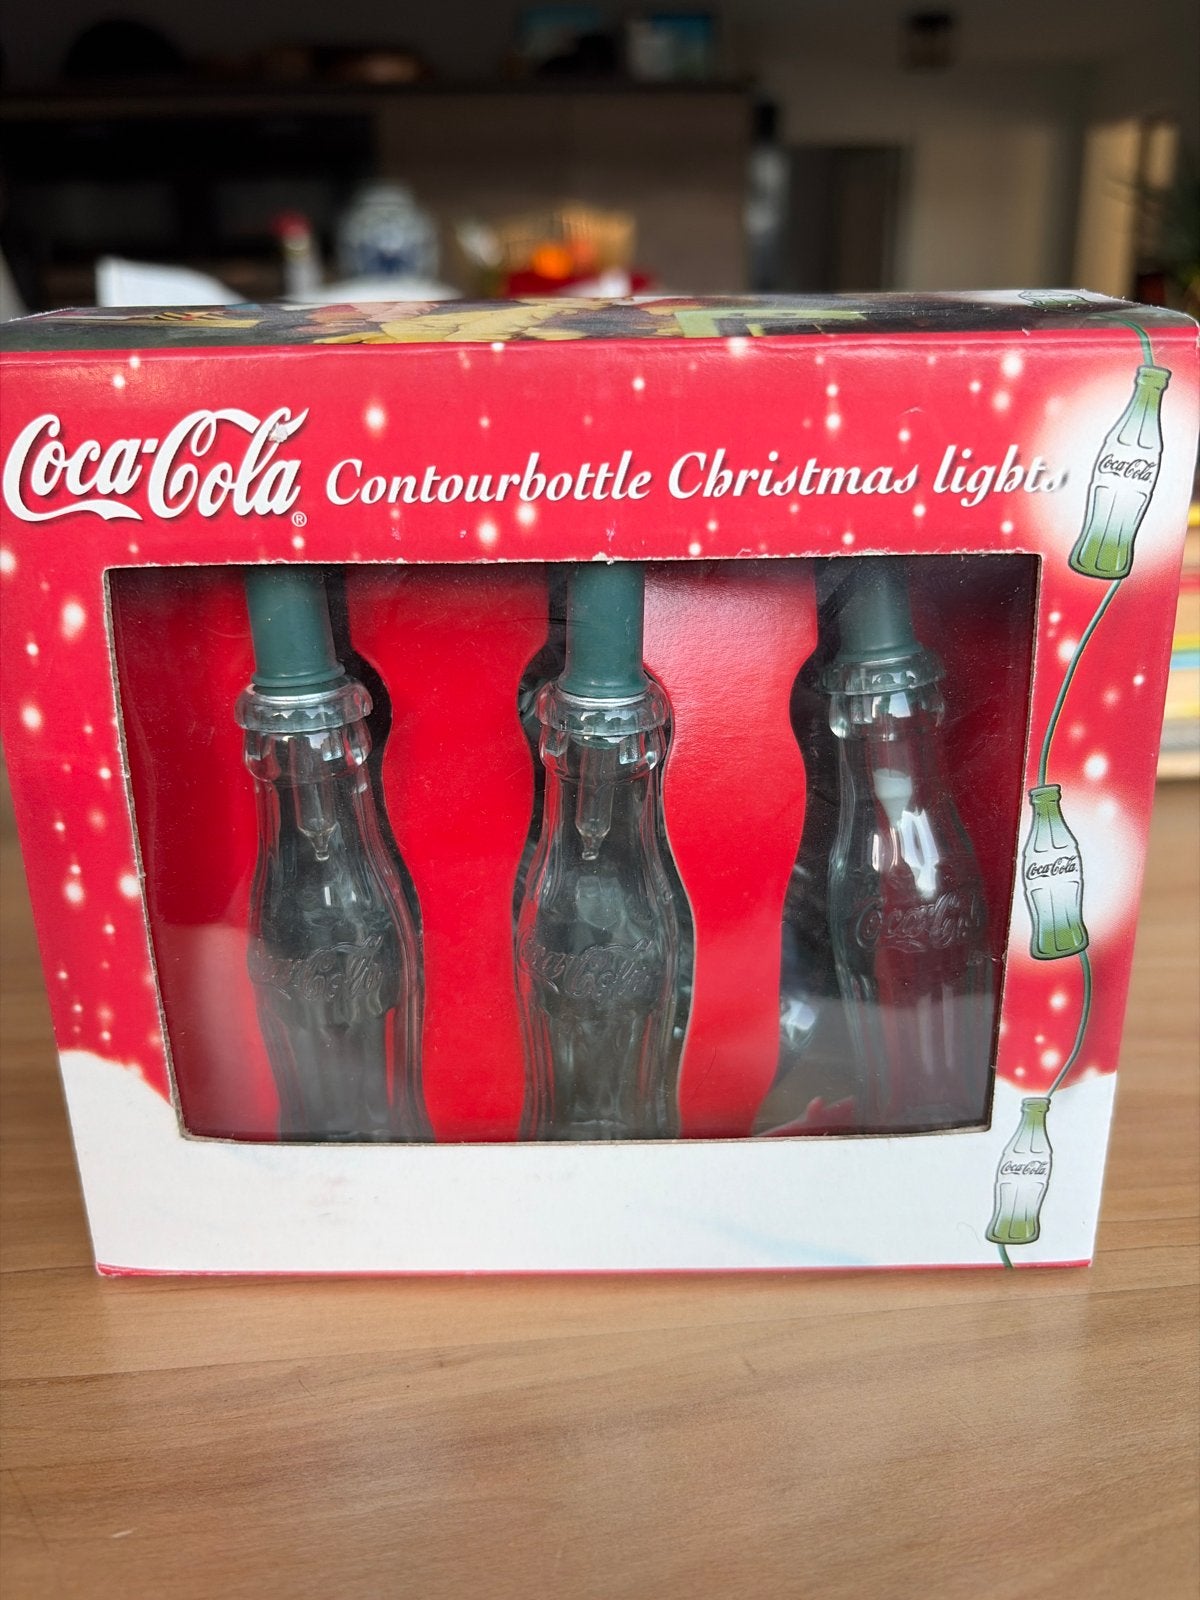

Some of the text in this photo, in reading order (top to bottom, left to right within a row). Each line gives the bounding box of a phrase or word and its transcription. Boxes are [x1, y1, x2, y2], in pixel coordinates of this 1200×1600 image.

[3, 408, 309, 521] Coca-Cola
[325, 443, 1067, 508] Contourbottle Christmas lights
